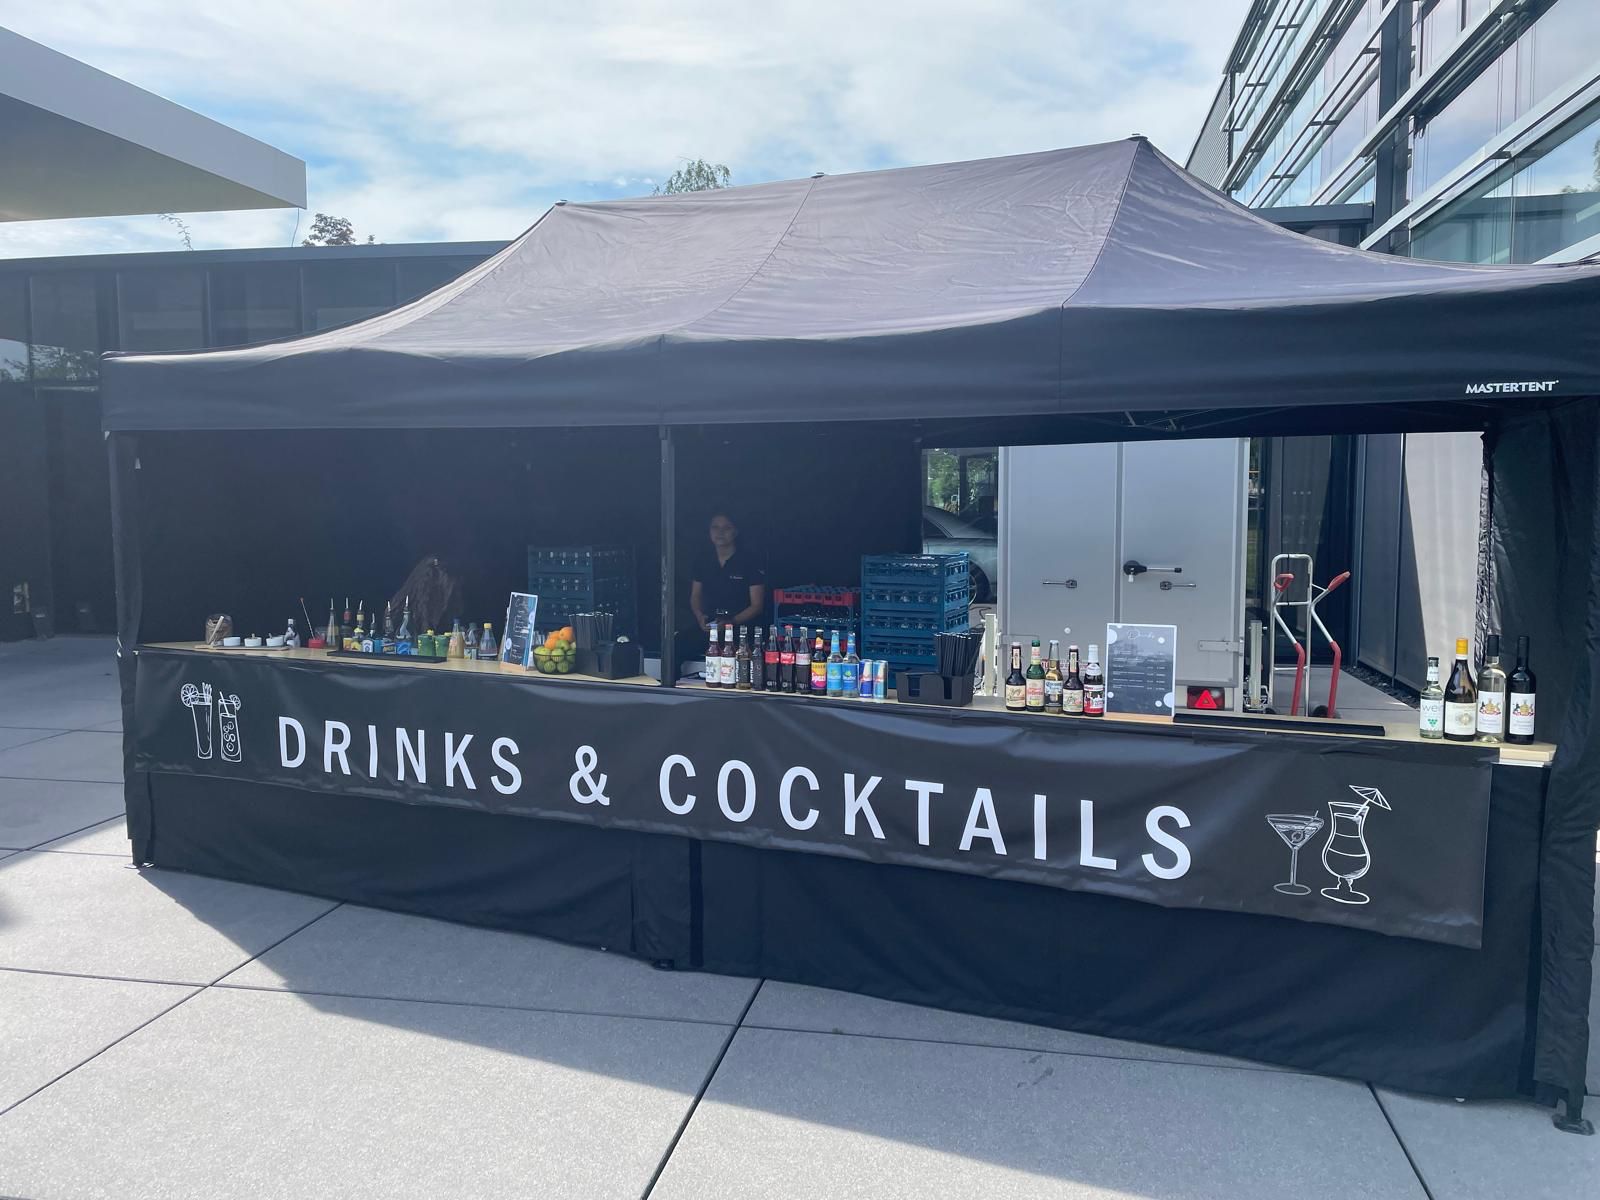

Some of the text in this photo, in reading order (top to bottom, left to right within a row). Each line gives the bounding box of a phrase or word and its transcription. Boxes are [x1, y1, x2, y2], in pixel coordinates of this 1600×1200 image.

[1465, 381, 1557, 394] MASTERTENT
[278, 716, 1191, 880] DRINKS & COCKTAILS
